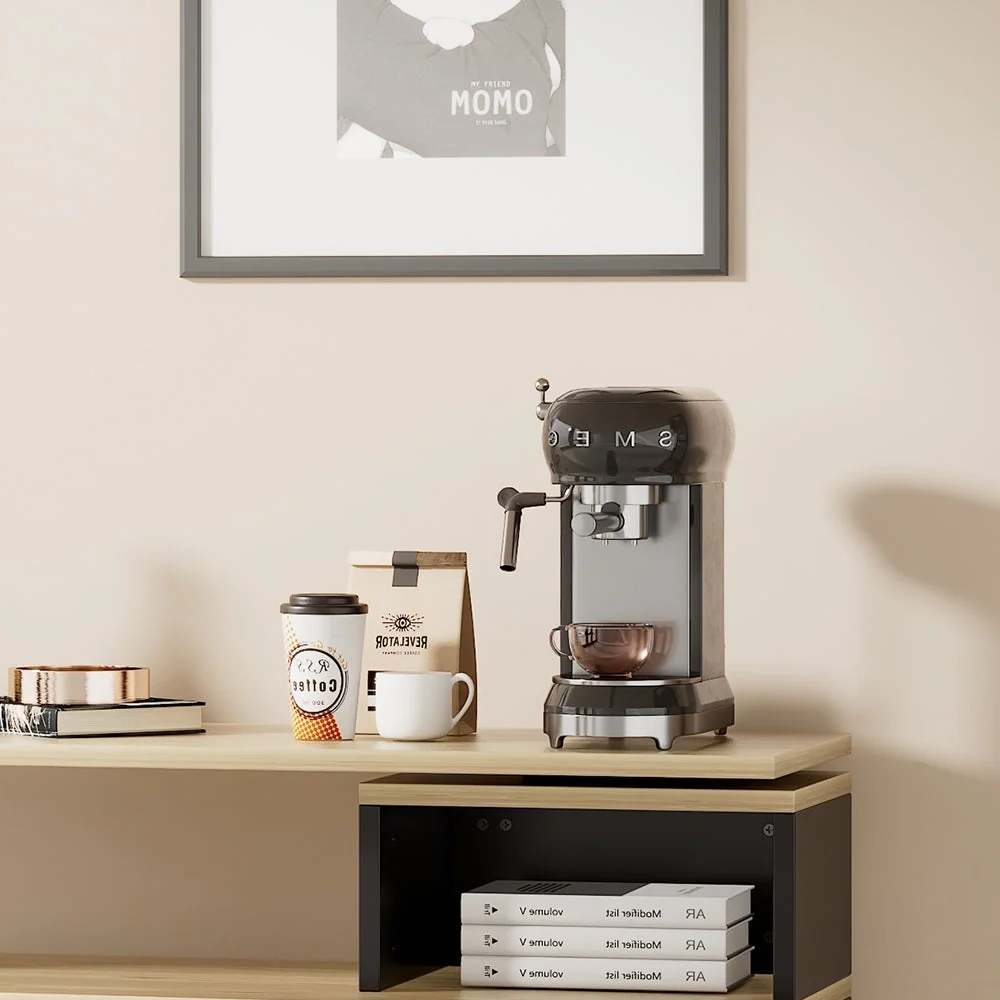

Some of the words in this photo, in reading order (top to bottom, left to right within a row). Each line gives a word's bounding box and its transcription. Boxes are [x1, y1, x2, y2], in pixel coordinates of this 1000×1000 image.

[470, 80, 481, 88] MY
[484, 80, 511, 88] FRIEND
[450, 89, 533, 116] MOMO
